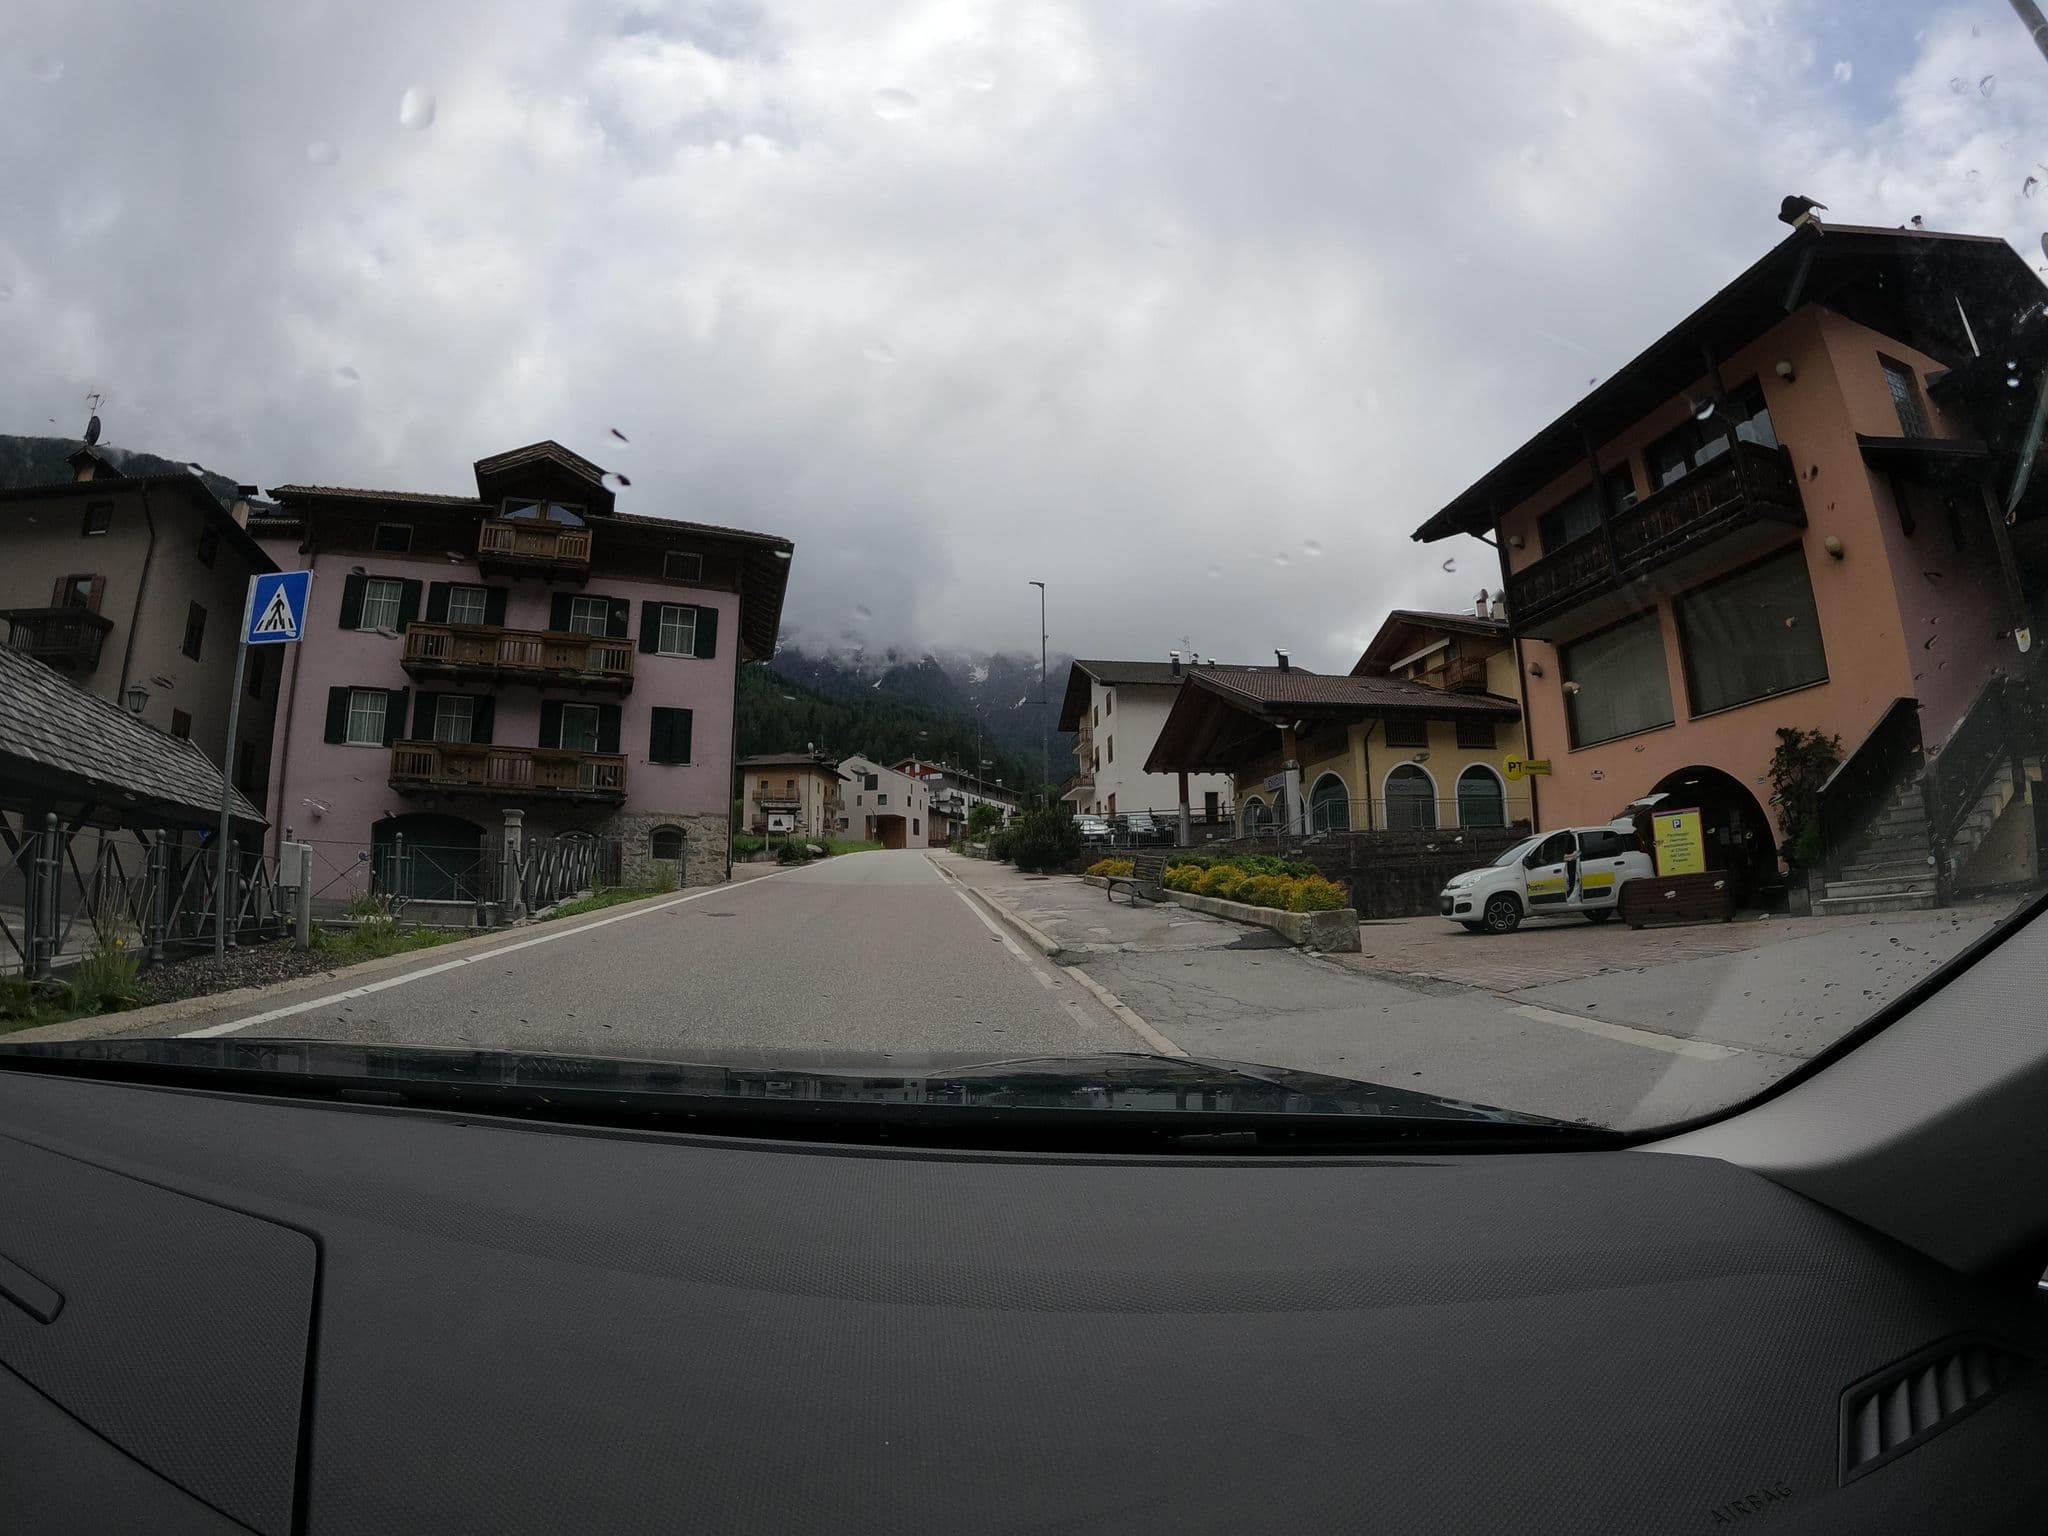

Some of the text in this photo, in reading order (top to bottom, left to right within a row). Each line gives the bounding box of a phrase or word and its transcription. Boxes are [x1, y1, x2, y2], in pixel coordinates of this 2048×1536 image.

[1508, 761, 1522, 773] PT
[1673, 820, 1681, 828] P
[1711, 1481, 1793, 1524] AIRBAG
